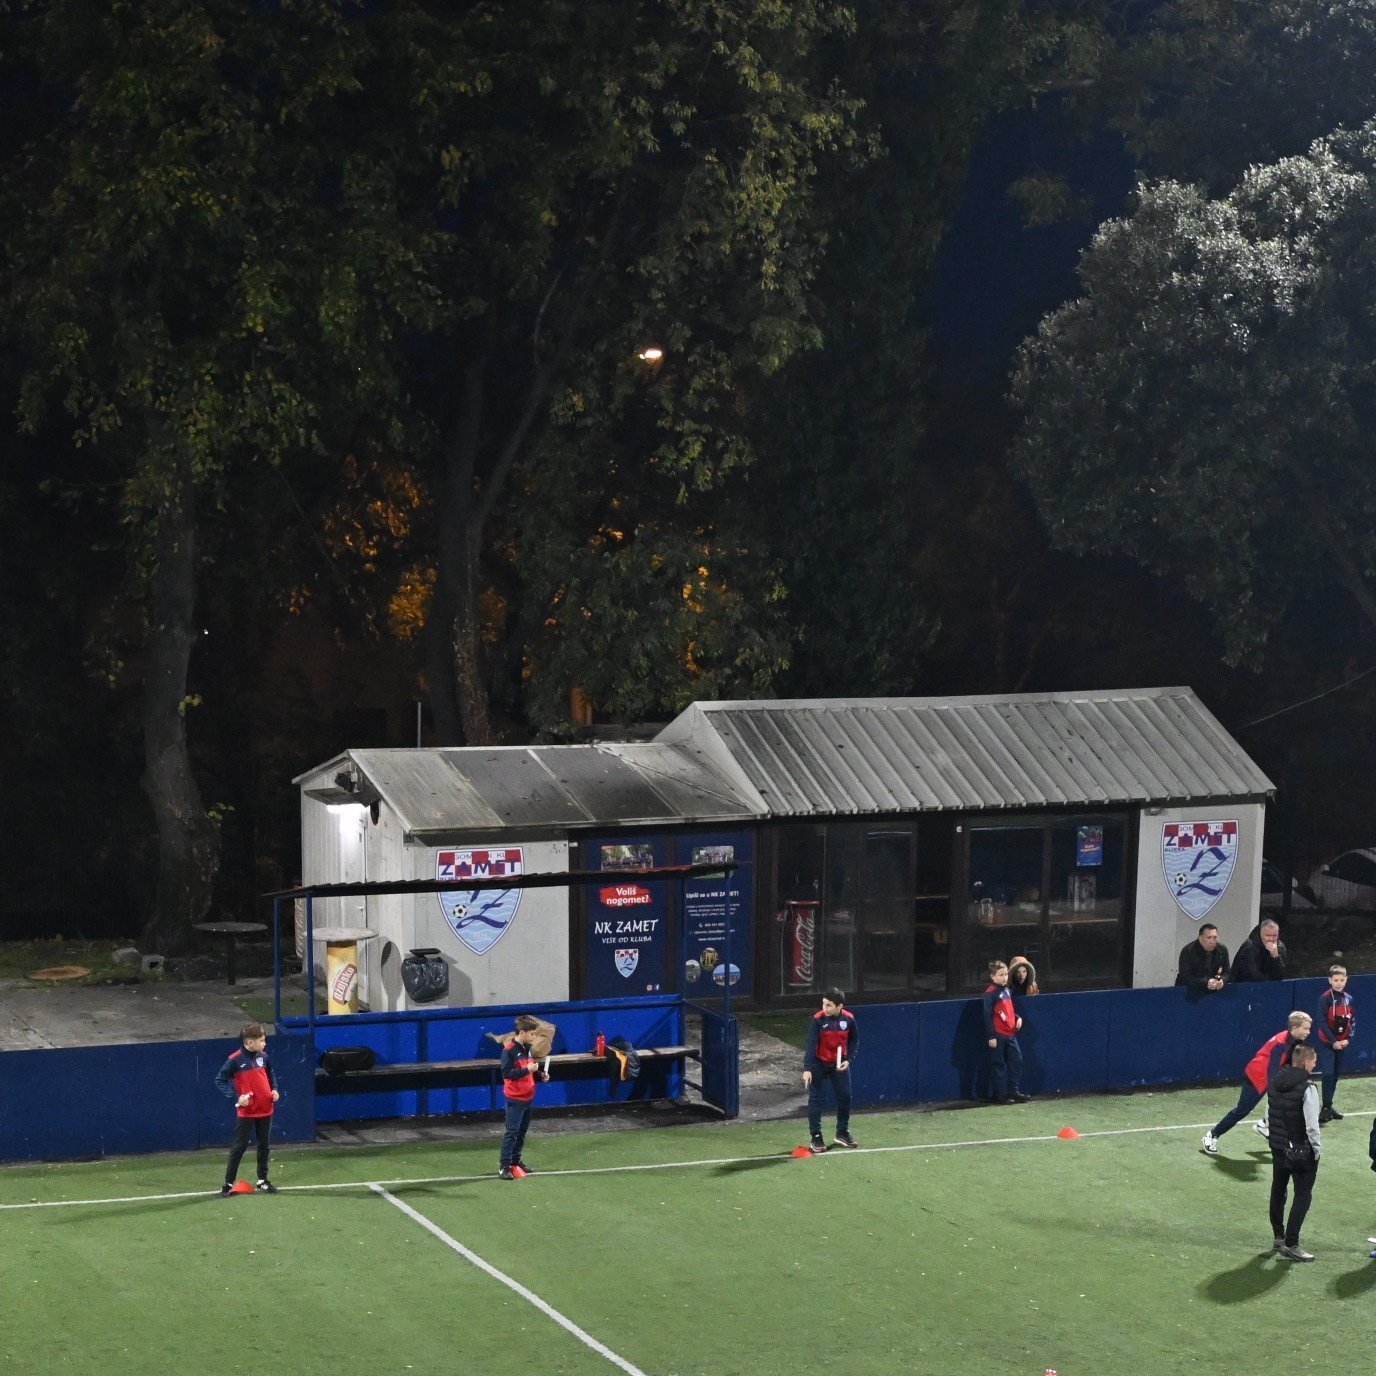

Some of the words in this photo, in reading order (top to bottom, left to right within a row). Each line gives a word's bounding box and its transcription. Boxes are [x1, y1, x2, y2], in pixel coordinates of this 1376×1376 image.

[615, 885, 637, 896] Voliš
[606, 895, 650, 907] nogomet?
[594, 921, 613, 934] NK
[615, 918, 659, 933] ZAMET
[795, 909, 815, 981] Coca-Cola
